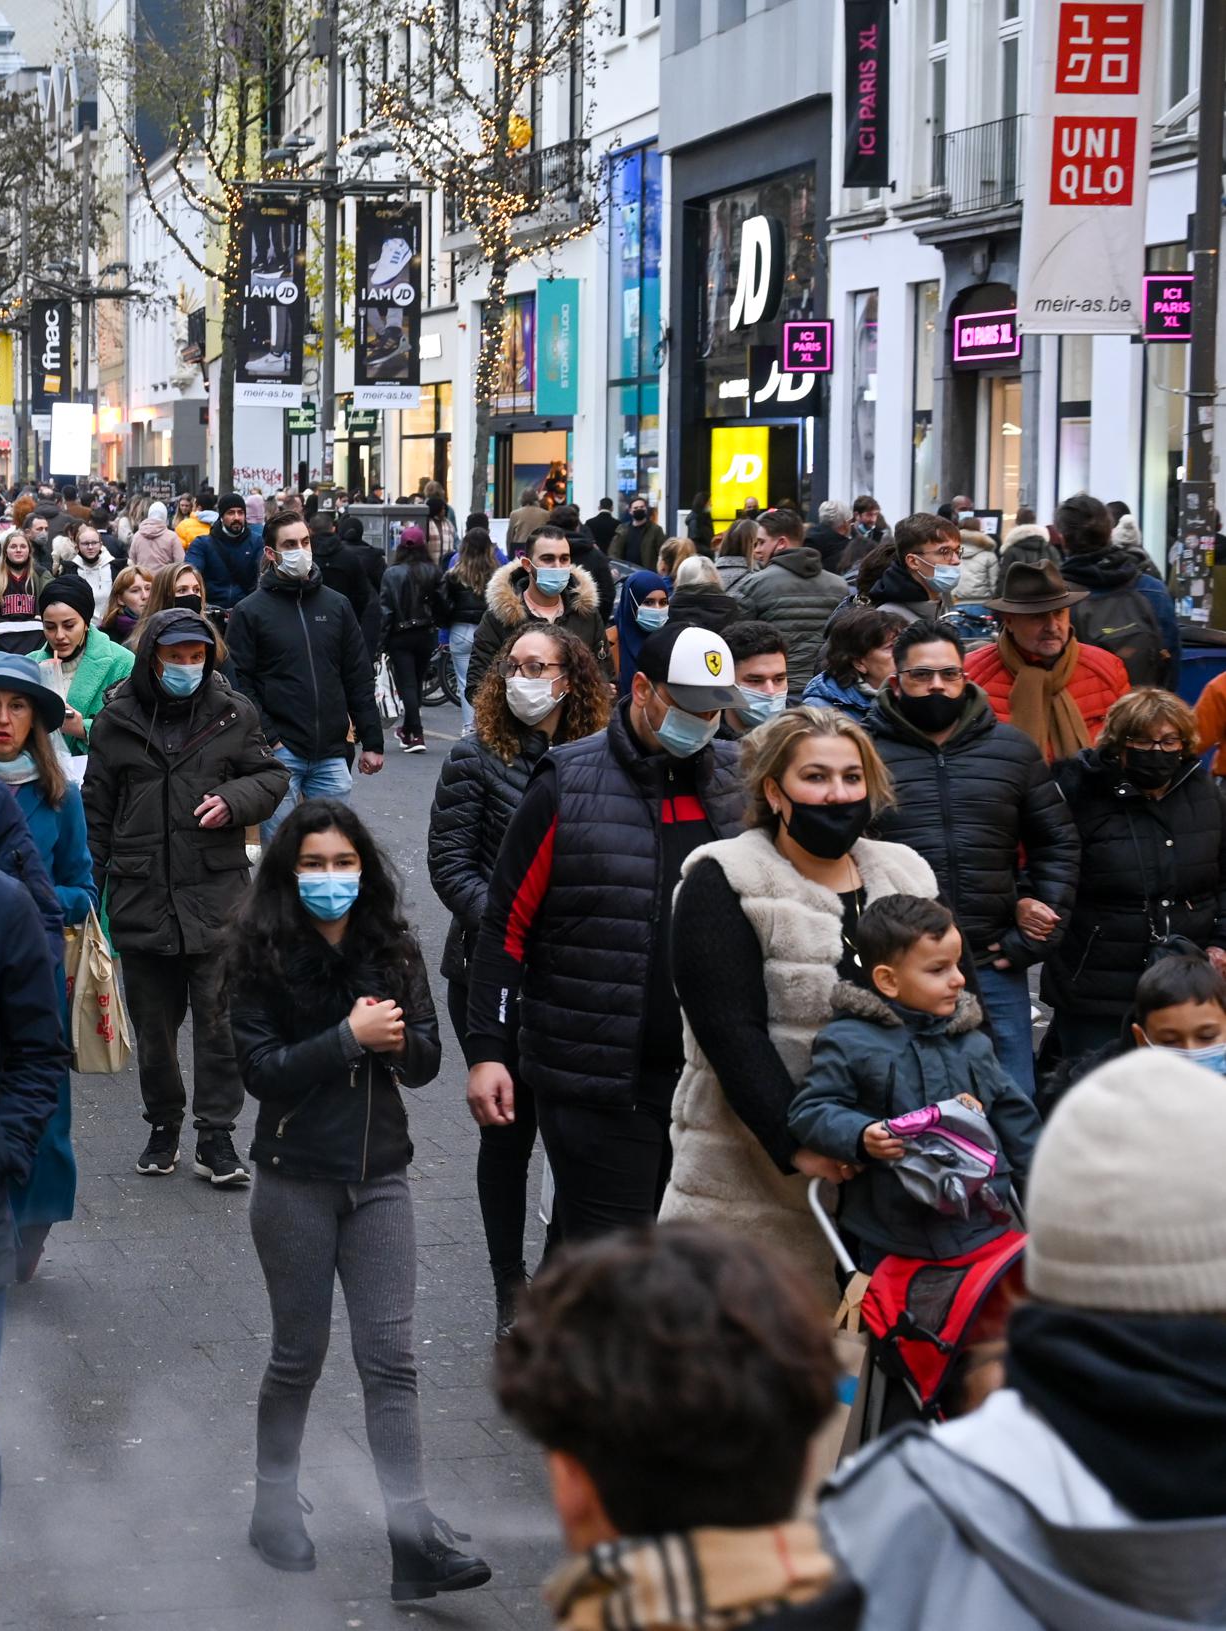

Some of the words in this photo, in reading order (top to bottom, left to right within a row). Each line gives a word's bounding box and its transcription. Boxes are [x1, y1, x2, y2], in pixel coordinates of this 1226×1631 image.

[859, 24, 877, 50] XL
[859, 59, 877, 119] PARIS
[859, 127, 876, 155] ICI
[1061, 128, 1120, 158] UNI
[1059, 164, 1124, 200] QLO
[729, 215, 772, 331] JD
[244, 285, 249, 297] I
[250, 285, 274, 298] AM
[361, 288, 366, 301] I
[367, 288, 392, 301] AM
[1163, 288, 1182, 299] ICI
[1035, 296, 1131, 313] meir-as.be
[1153, 302, 1190, 313] PARIS
[1163, 316, 1180, 327] XL
[42, 309, 61, 370] fnac
[800, 332, 814, 341] ICI
[793, 343, 821, 352] PARIS
[800, 353, 814, 362] XL
[243, 388, 294, 399] meir-as.be
[362, 389, 413, 400] meir-as.be
[719, 454, 763, 484] JD
